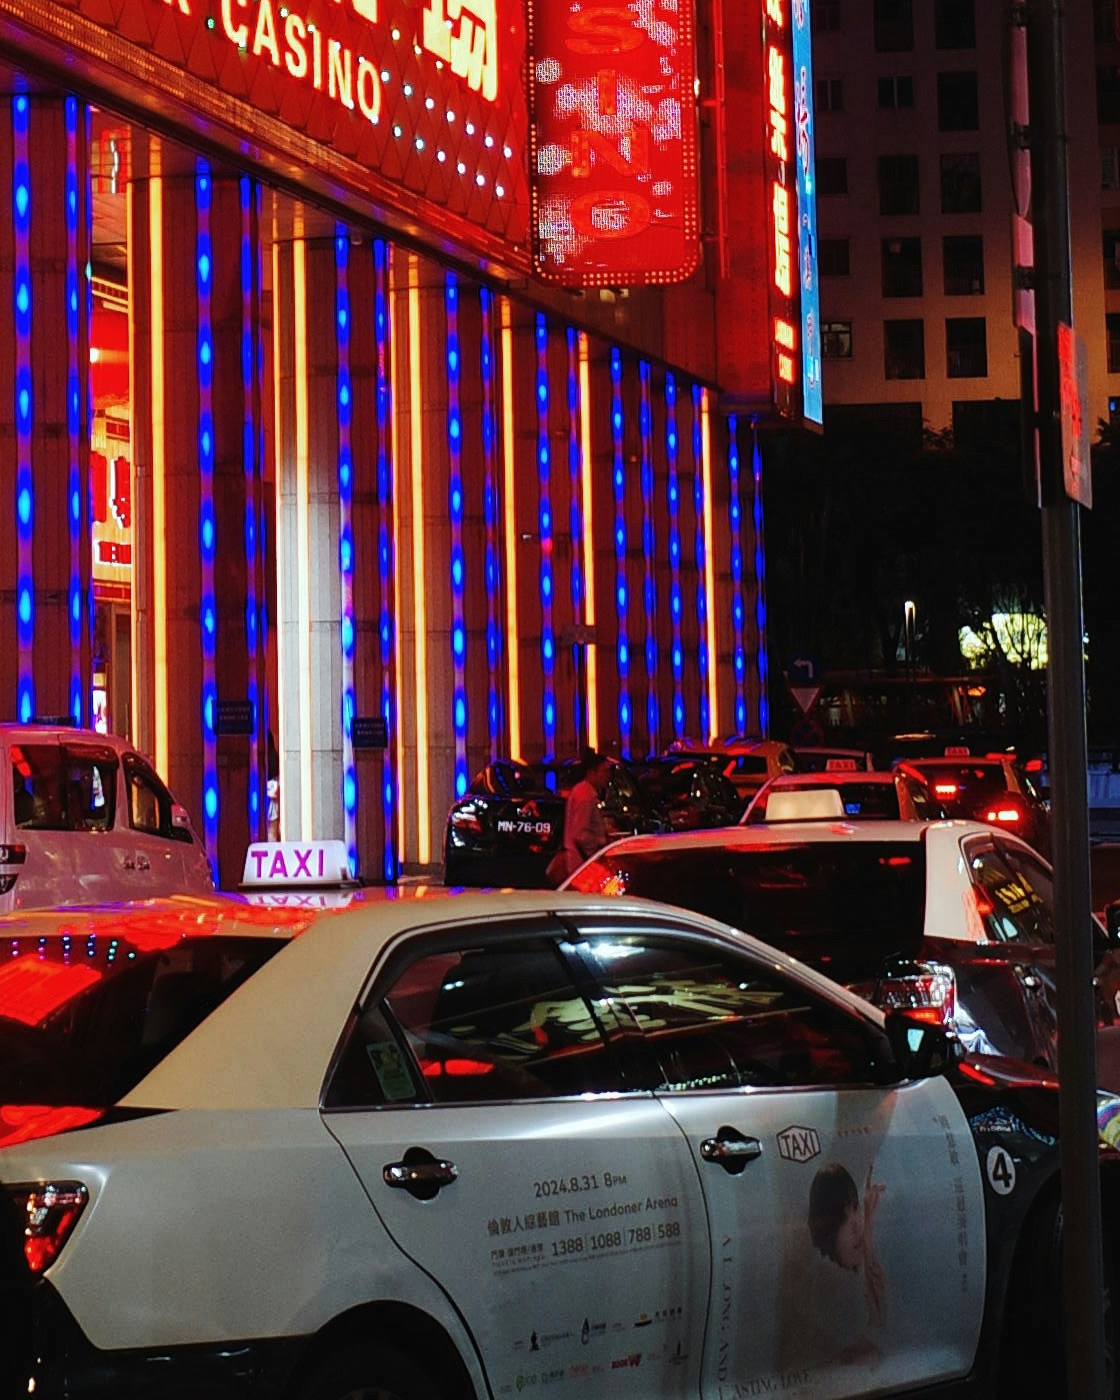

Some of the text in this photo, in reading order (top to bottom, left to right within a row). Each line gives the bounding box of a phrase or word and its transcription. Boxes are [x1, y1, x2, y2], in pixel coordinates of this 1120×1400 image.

[251, 849, 324, 878] TAXI
[780, 1130, 818, 1159] TAXI
[992, 1153, 1013, 1188] 4
[533, 1175, 599, 1198] 2024.8.31
[564, 1209, 586, 1224] The
[588, 1202, 643, 1221] Londoner
[645, 1196, 679, 1211] Arena
[551, 1239, 584, 1256] 1388
[590, 1231, 622, 1249] 1088
[629, 1226, 652, 1244] 788
[657, 1221, 681, 1238] 588
